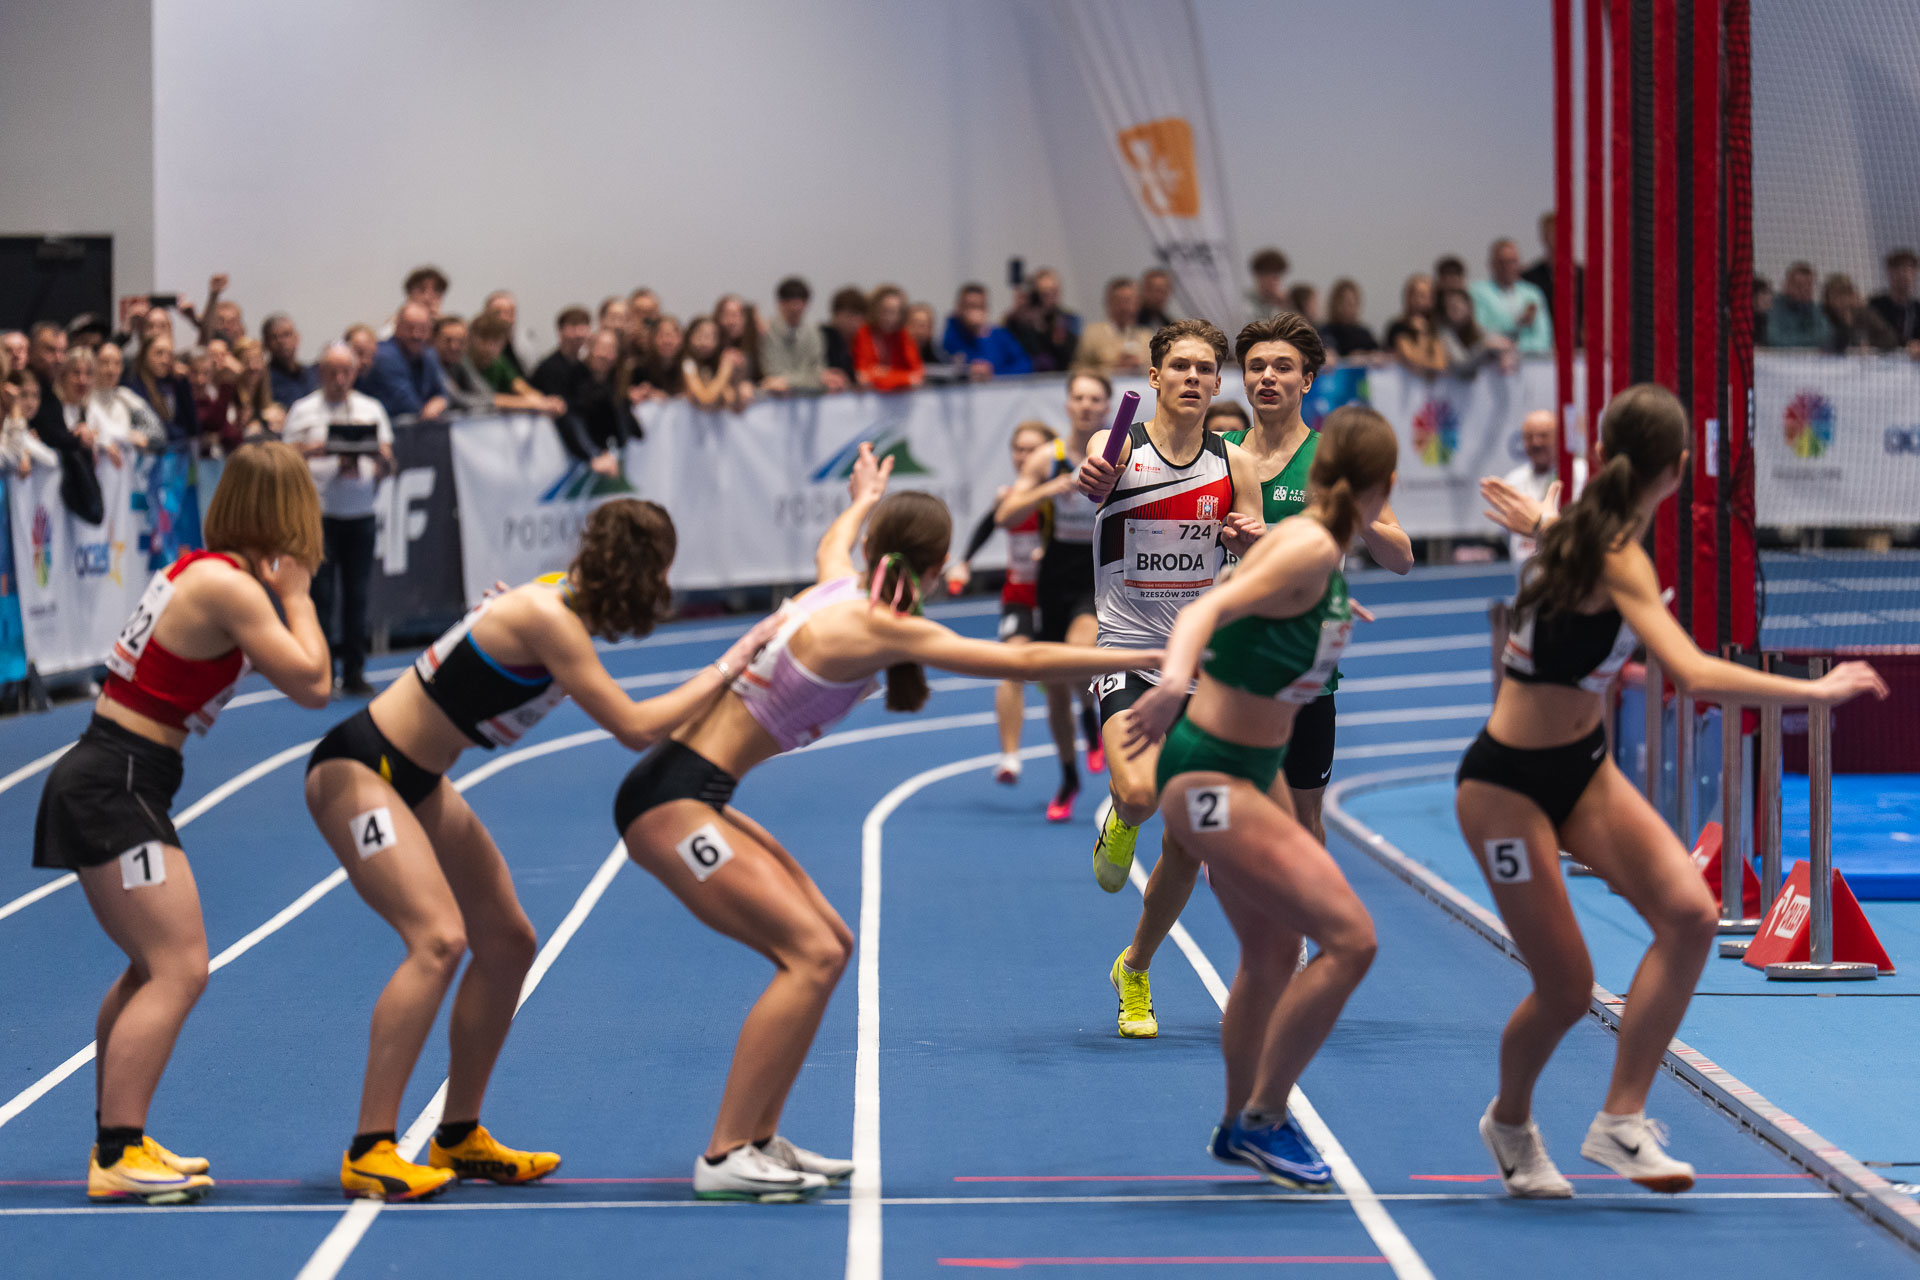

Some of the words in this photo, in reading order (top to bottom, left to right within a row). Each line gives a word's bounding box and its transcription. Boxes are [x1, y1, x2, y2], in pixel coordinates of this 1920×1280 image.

[1179, 524, 1211, 540] 724
[1136, 553, 1204, 571] BRODA
[1140, 589, 1180, 598] RZESZÓW
[1198, 792, 1219, 827] 2
[363, 816, 385, 846] 4
[133, 846, 151, 881] 1
[692, 836, 719, 867] 6
[1496, 844, 1519, 878] 5
